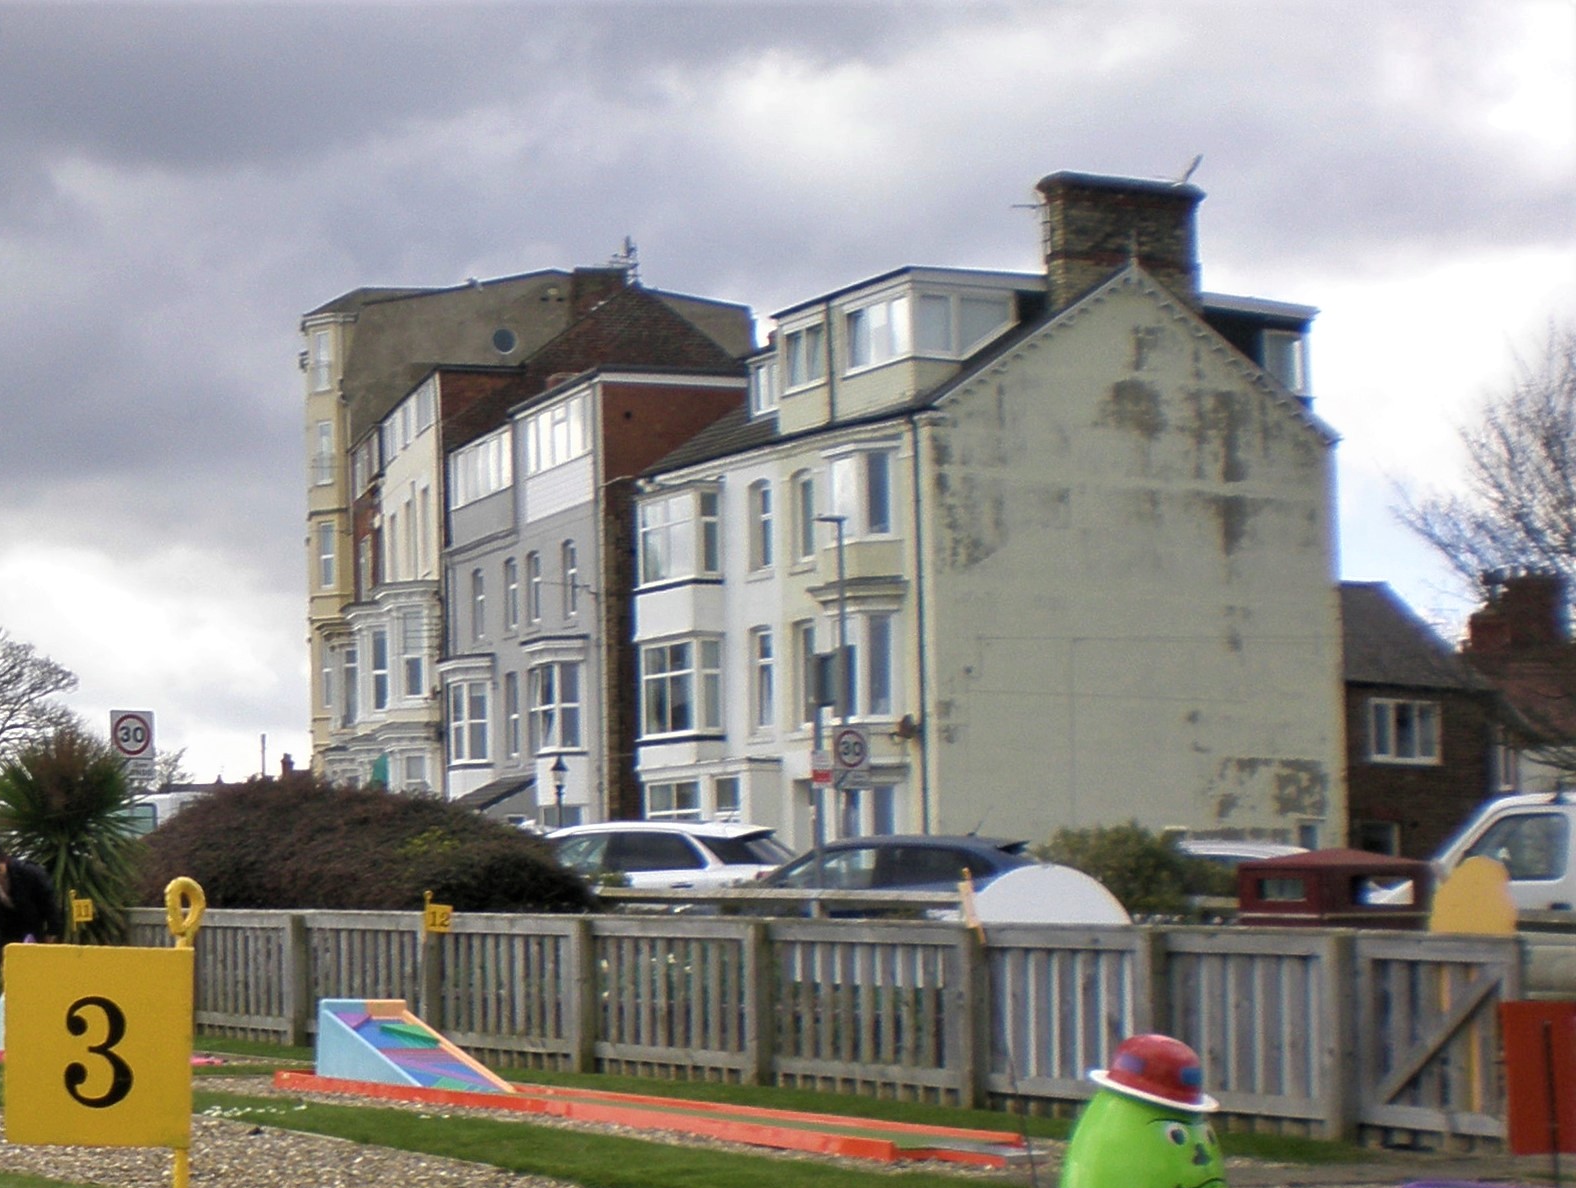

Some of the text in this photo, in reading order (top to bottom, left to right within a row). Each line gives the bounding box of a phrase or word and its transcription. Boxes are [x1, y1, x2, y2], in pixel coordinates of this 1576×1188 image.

[120, 726, 145, 742] 30
[842, 741, 863, 756] 30
[430, 911, 450, 927] 12
[64, 996, 133, 1108] 3
